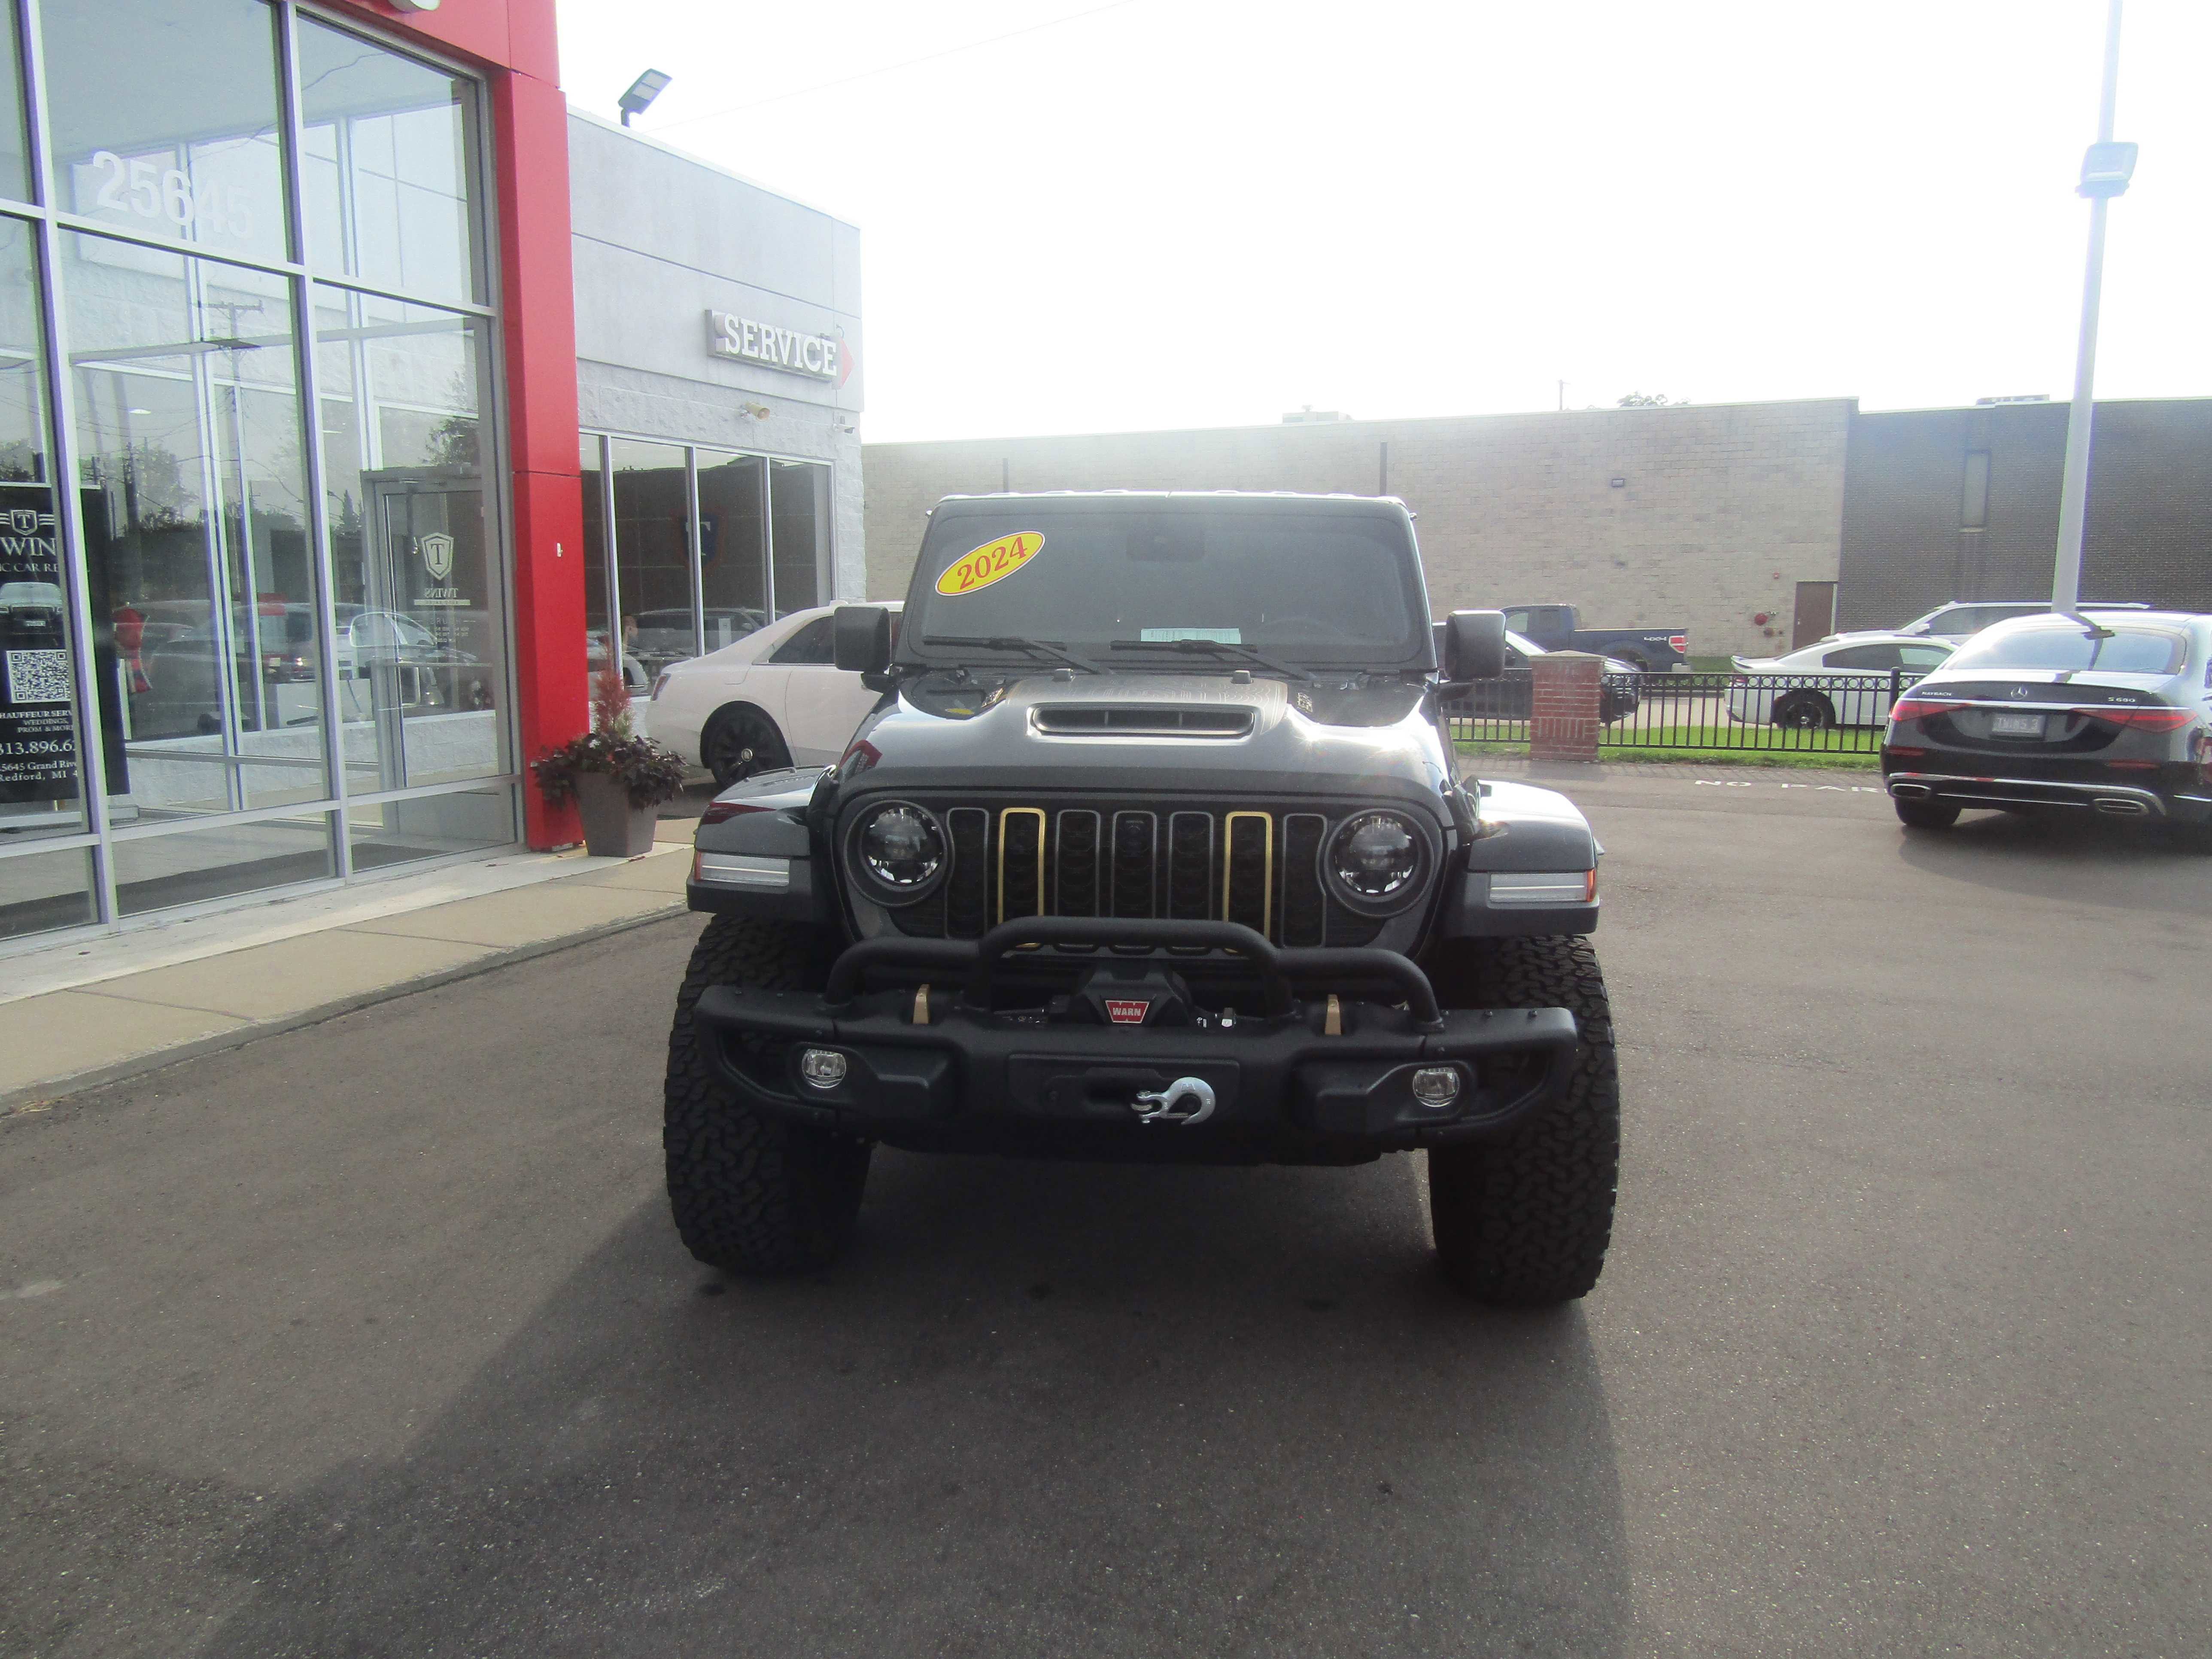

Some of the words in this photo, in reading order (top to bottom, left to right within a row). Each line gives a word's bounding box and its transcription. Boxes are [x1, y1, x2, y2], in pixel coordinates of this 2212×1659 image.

[93, 151, 253, 239] 25645
[724, 313, 837, 376] SERVICE
[13, 563, 41, 572] CAR
[957, 537, 1027, 590] 2024
[0, 763, 25, 772] 5645
[27, 760, 57, 770] Grand
[52, 771, 67, 779] MI
[1781, 783, 1887, 793] PAR
[1113, 1007, 1141, 1016] WARN
